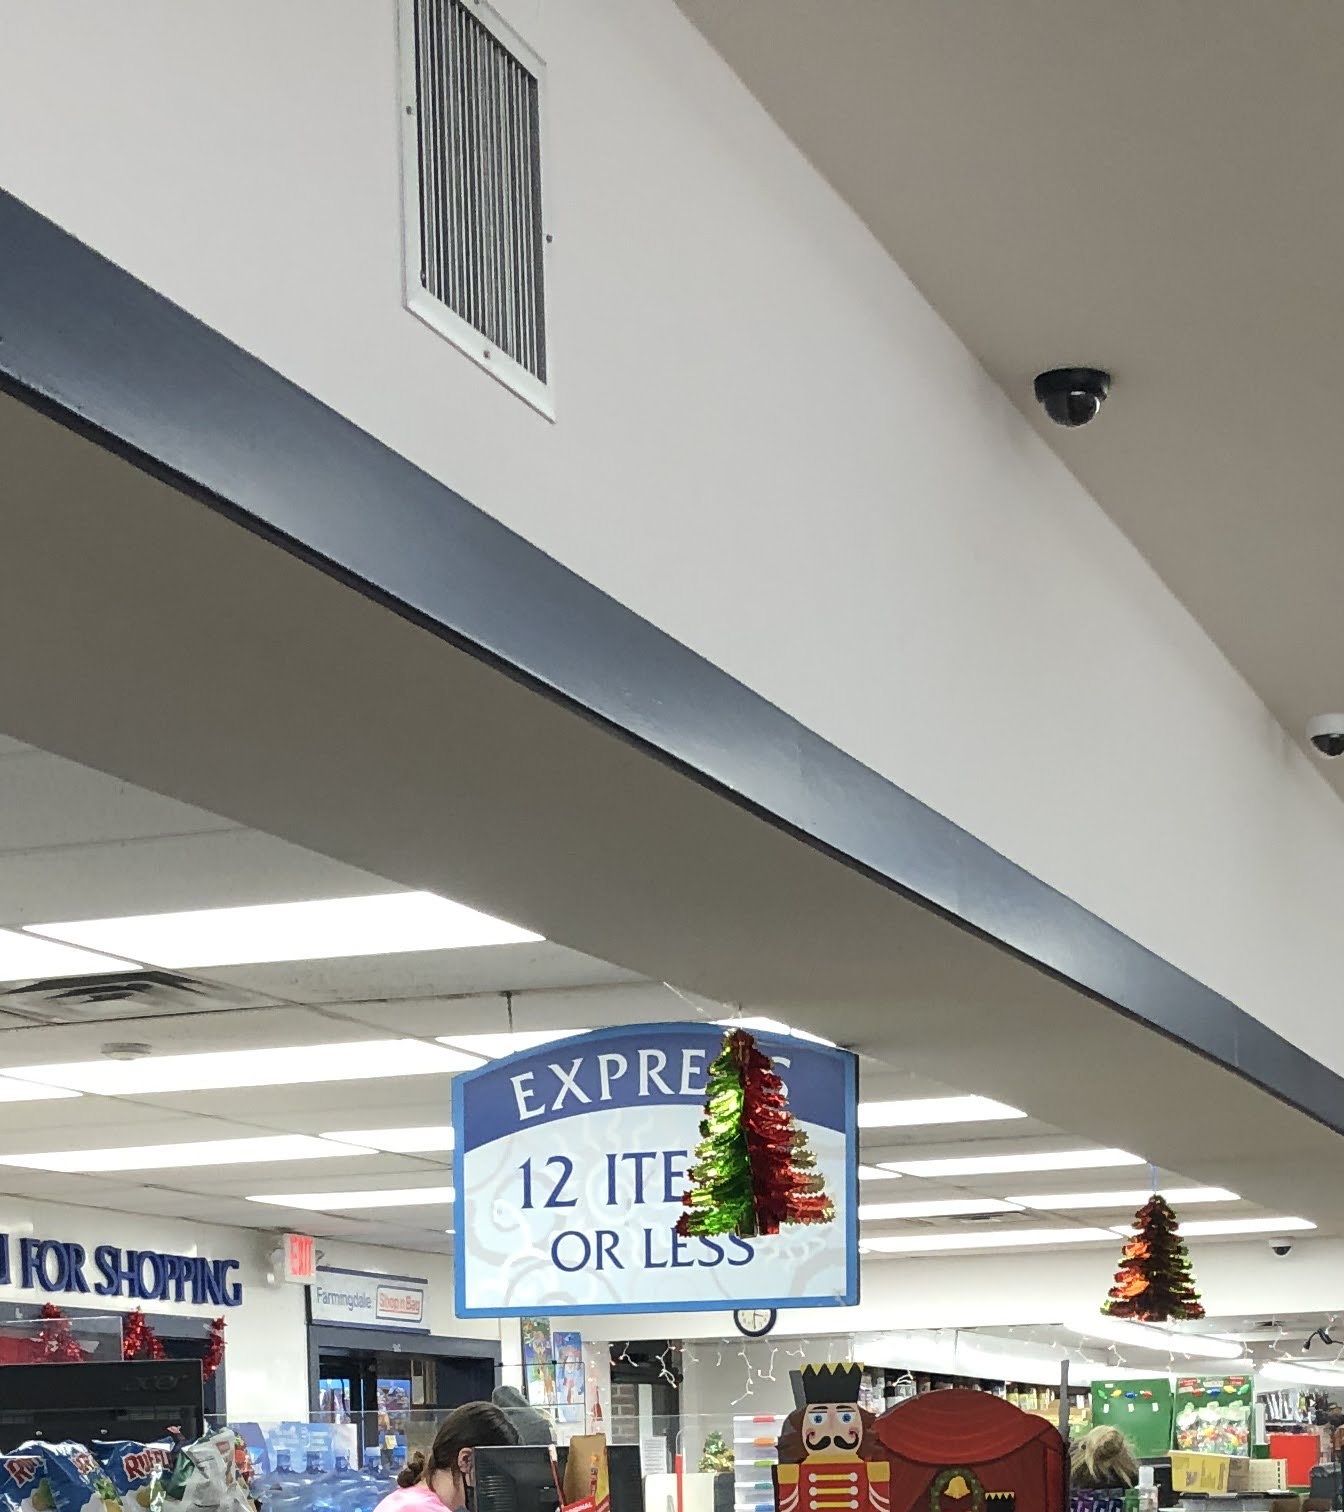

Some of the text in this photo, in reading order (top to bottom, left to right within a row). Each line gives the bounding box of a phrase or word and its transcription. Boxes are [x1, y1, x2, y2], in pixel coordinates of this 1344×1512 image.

[510, 1049, 790, 1121] EXPRE
[518, 1150, 688, 1210] 12 ITE
[20, 1237, 90, 1293] FOR
[94, 1244, 244, 1307] SHOPPING
[290, 1234, 314, 1277] EXIT
[550, 1228, 755, 1272] OR LESS
[317, 1287, 371, 1311] Farmingdale
